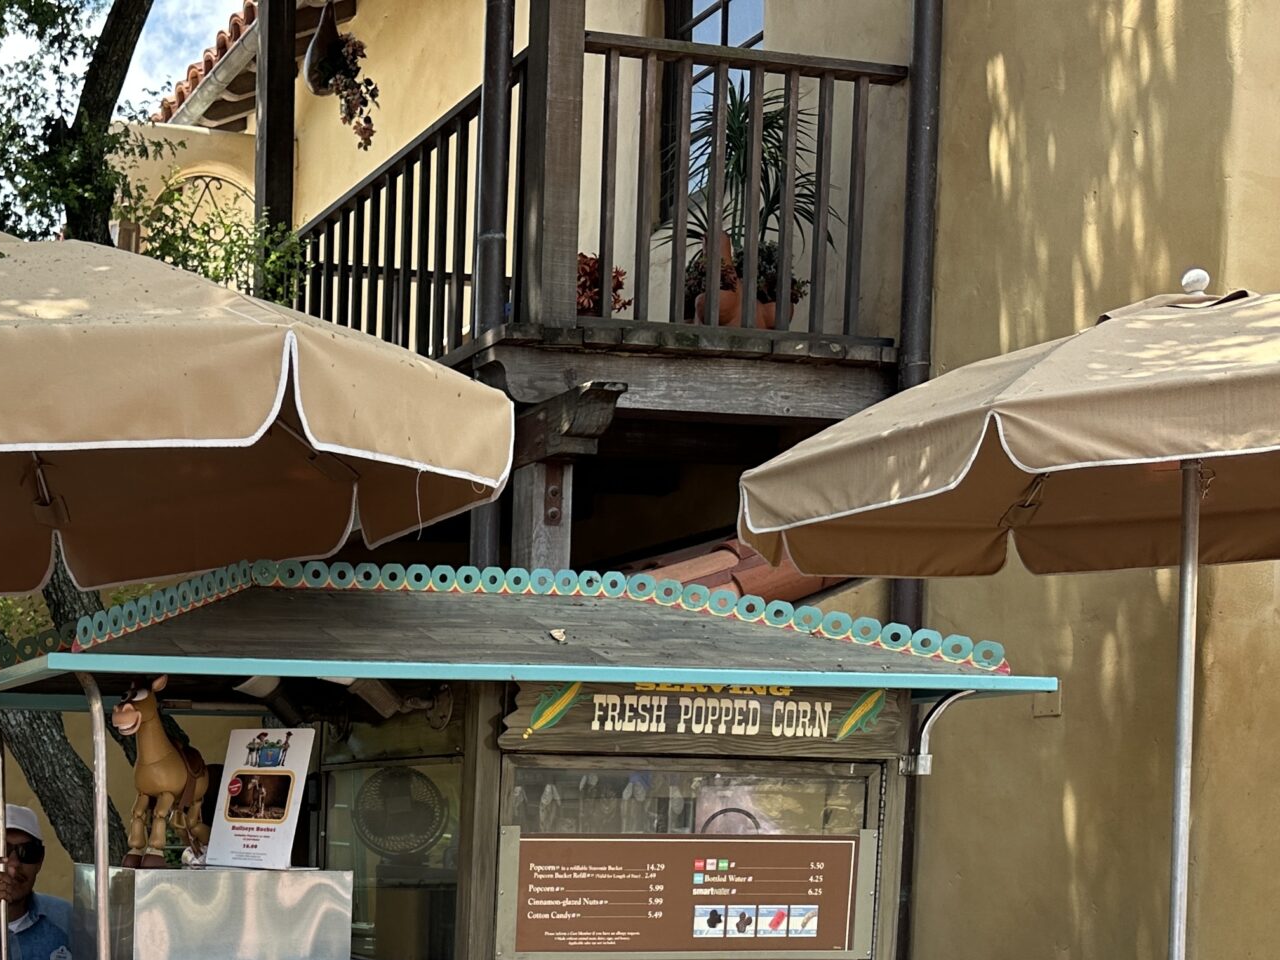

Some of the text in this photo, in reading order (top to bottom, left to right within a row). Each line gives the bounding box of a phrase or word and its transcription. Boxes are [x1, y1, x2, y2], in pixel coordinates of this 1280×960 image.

[591, 694, 832, 738] FRESH POPPED CORN
[529, 863, 556, 873] Popcorn
[646, 863, 665, 871] 14.29
[809, 862, 825, 870] 5.50
[705, 875, 727, 883] Bottled
[728, 875, 747, 883] Water
[809, 875, 824, 883] 4.25
[528, 884, 664, 894] Popcorn 5.99
[808, 888, 823, 896] 6.25
[528, 898, 664, 907] Cinnamon-glazed Nuts 5.99
[527, 911, 550, 920] Cotton
[551, 911, 571, 921] Candy
